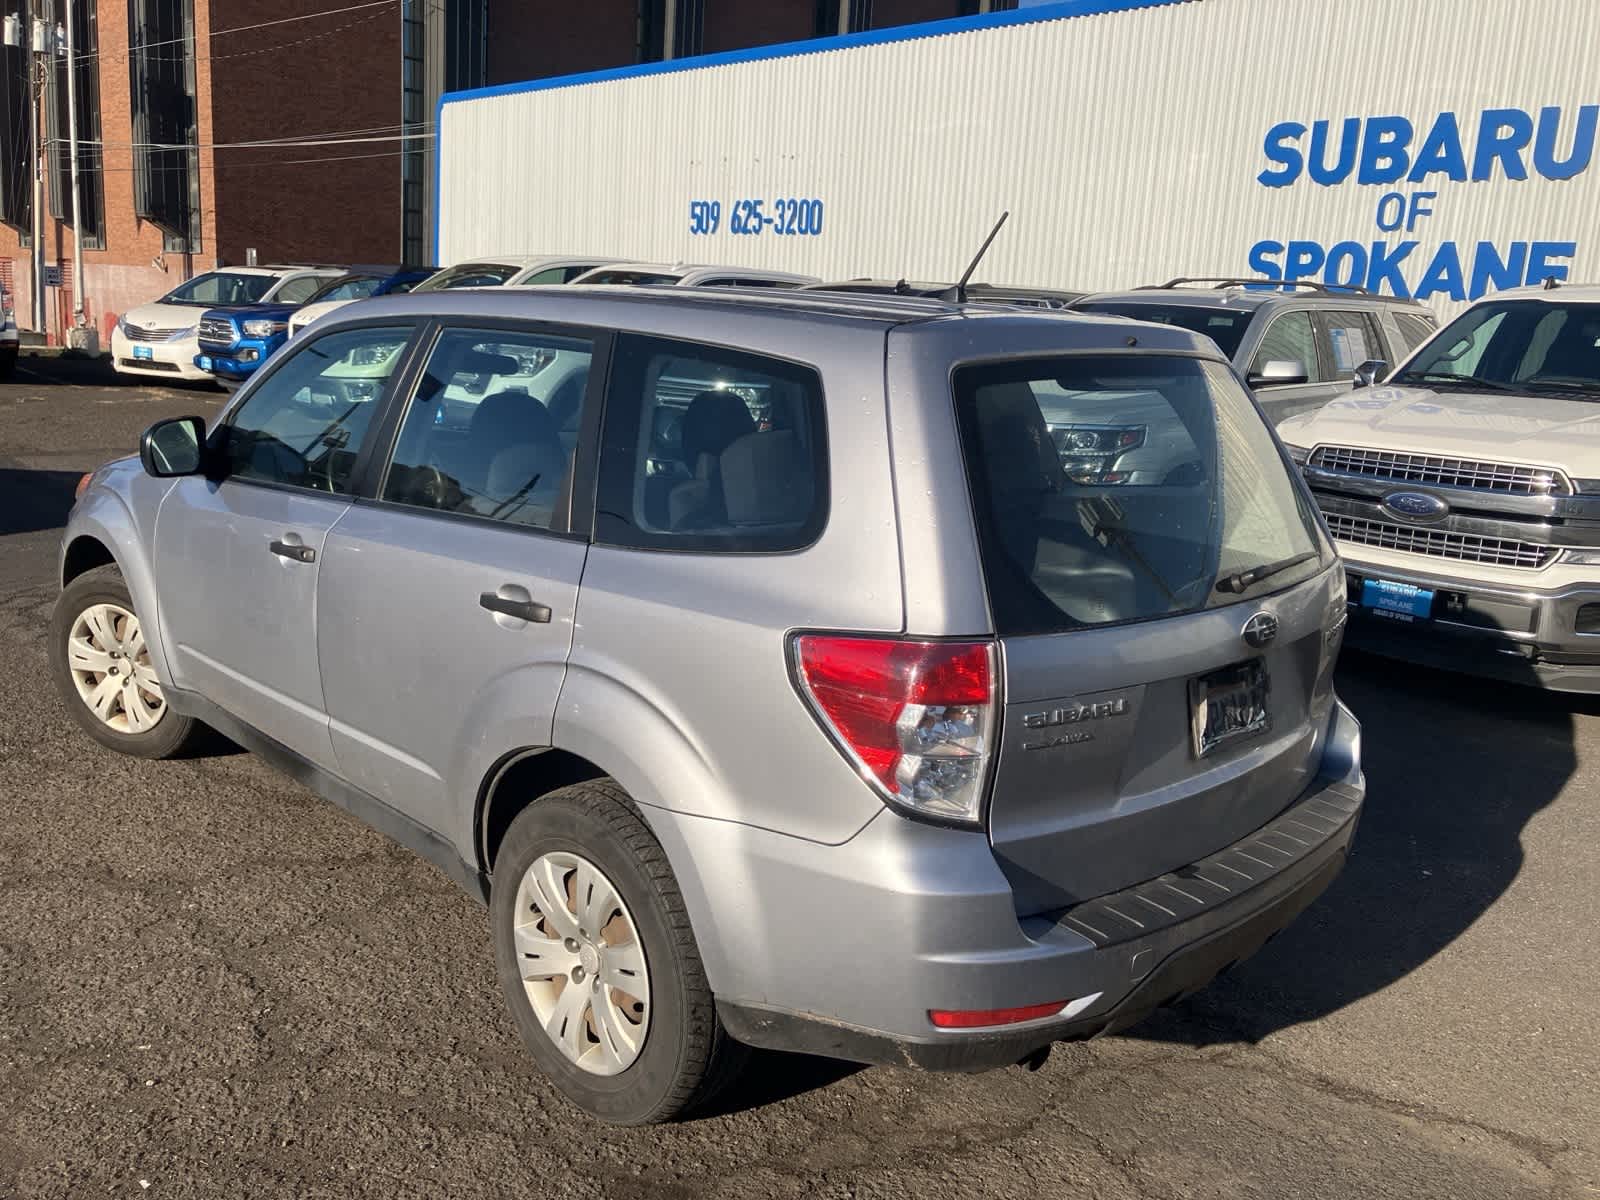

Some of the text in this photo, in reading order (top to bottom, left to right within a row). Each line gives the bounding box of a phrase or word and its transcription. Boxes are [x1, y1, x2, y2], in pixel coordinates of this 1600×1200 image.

[1257, 105, 1600, 188] SUBARU
[690, 199, 824, 235] 509 625-3200
[1376, 191, 1437, 232] OF
[1241, 240, 1577, 301] SPOKANE
[1379, 584, 1417, 598] SUBARU
[1024, 699, 1127, 728] SUBARU
